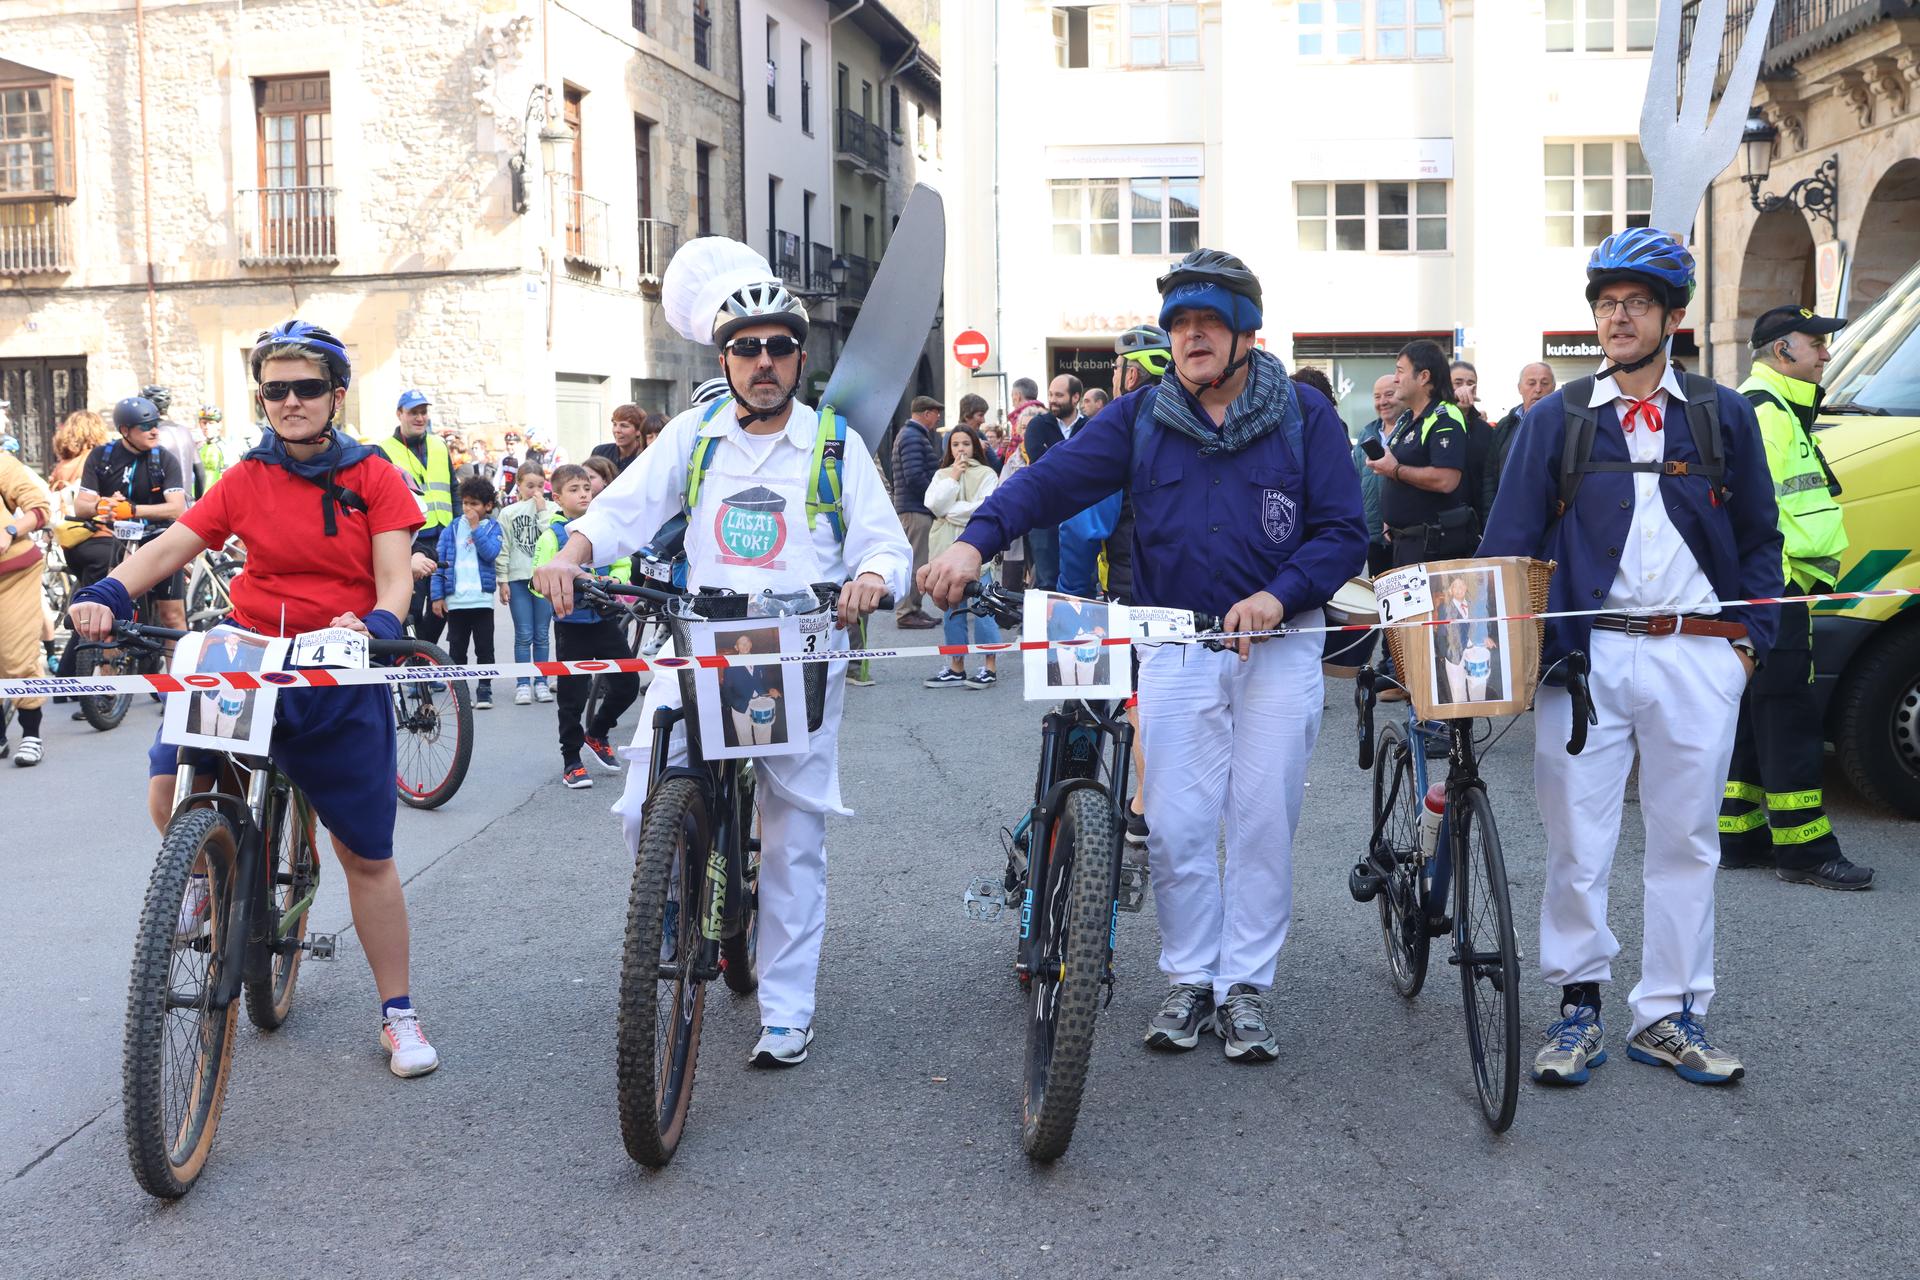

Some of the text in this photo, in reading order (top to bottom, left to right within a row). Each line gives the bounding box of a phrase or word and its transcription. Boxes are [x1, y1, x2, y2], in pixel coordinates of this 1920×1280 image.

[1546, 343, 1605, 356] kutxaban
[117, 528, 131, 538] 108
[644, 566, 655, 577] 38
[1382, 598, 1393, 621] 2
[1138, 621, 1149, 637] 1
[803, 634, 817, 652] 3
[311, 645, 325, 663] 4
[385, 670, 500, 680] UDALTZAINGOA
[4, 685, 117, 695] UDALTZAINGOA
[1803, 795, 1819, 804] DYA
[1720, 820, 1732, 828] DYA
[1803, 825, 1819, 837] DYA
[702, 864, 728, 941] FOX
